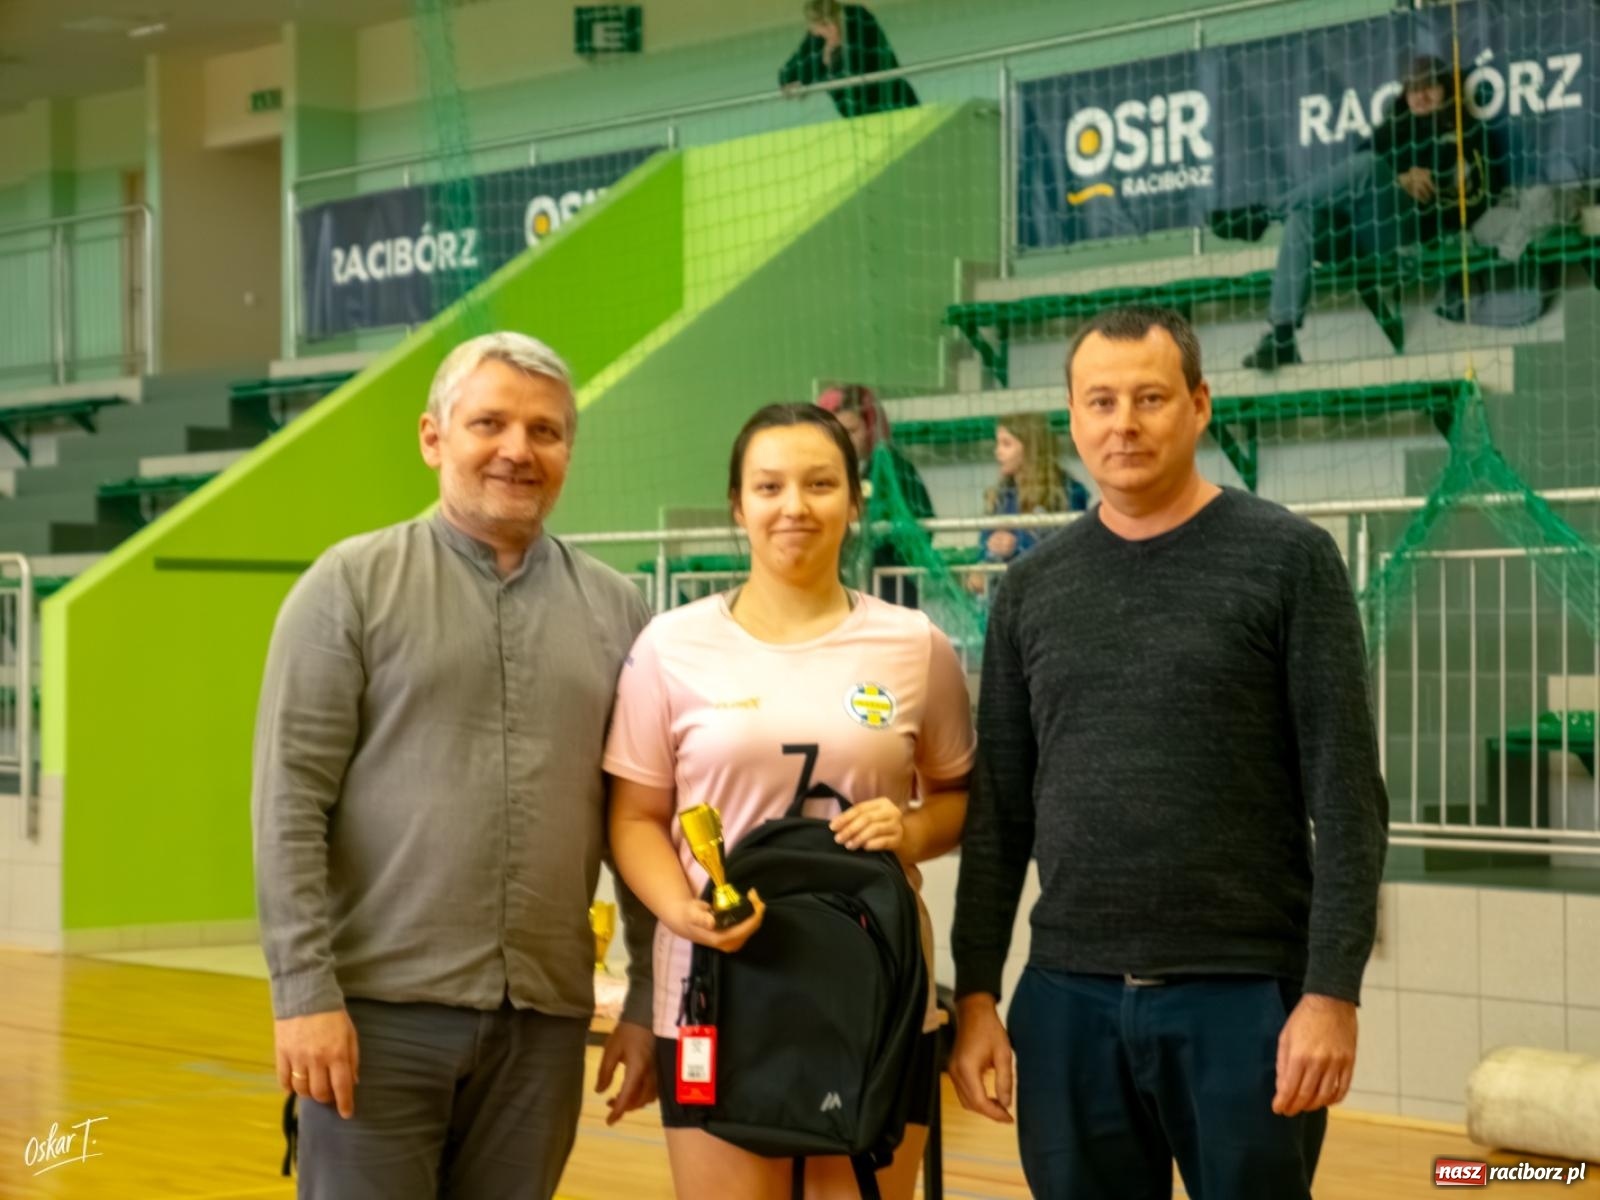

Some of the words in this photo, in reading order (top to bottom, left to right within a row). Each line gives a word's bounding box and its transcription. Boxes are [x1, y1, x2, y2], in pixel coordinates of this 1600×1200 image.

[1298, 49, 1583, 146] RACÓRZ
[1122, 166, 1214, 199] RACIBÓRZ
[782, 743, 819, 815] 7
